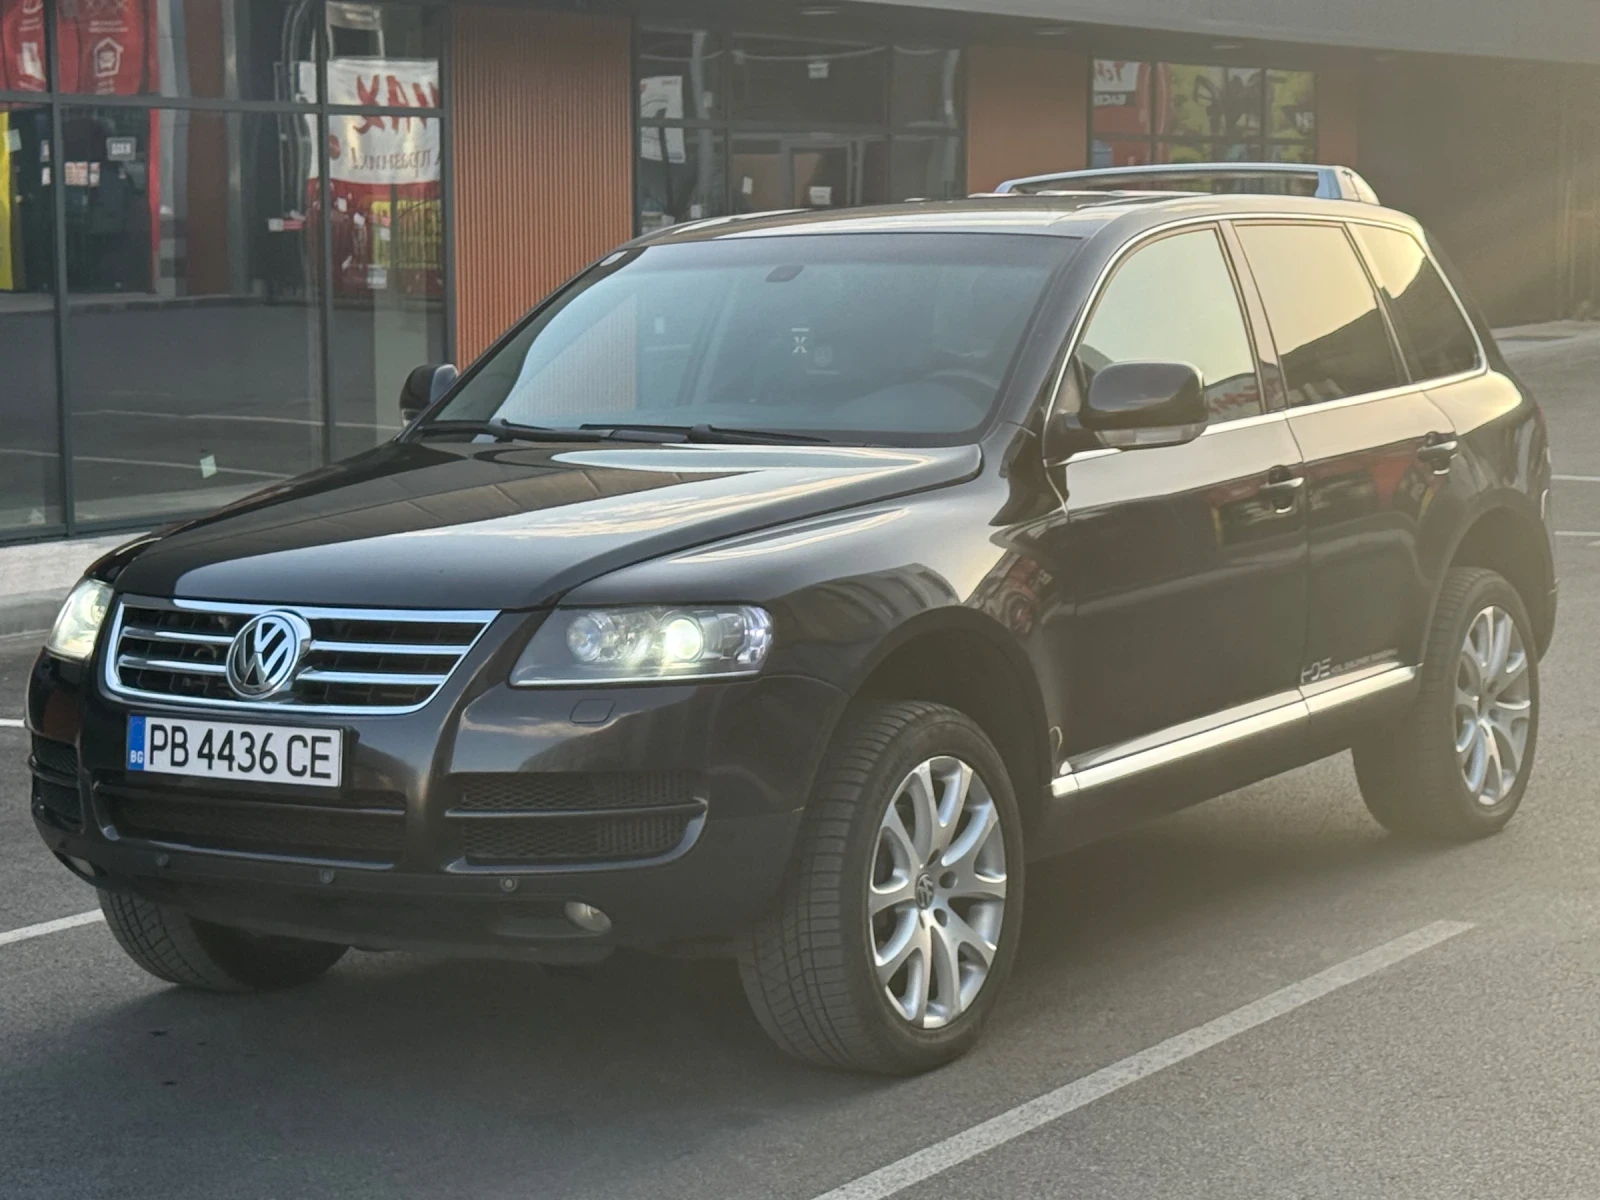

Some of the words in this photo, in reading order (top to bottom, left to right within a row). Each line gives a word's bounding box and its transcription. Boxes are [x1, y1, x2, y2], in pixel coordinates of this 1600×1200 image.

[130, 750, 144, 763] BG
[149, 723, 190, 767] PB
[197, 728, 278, 775] 4436
[286, 734, 332, 779] CE
